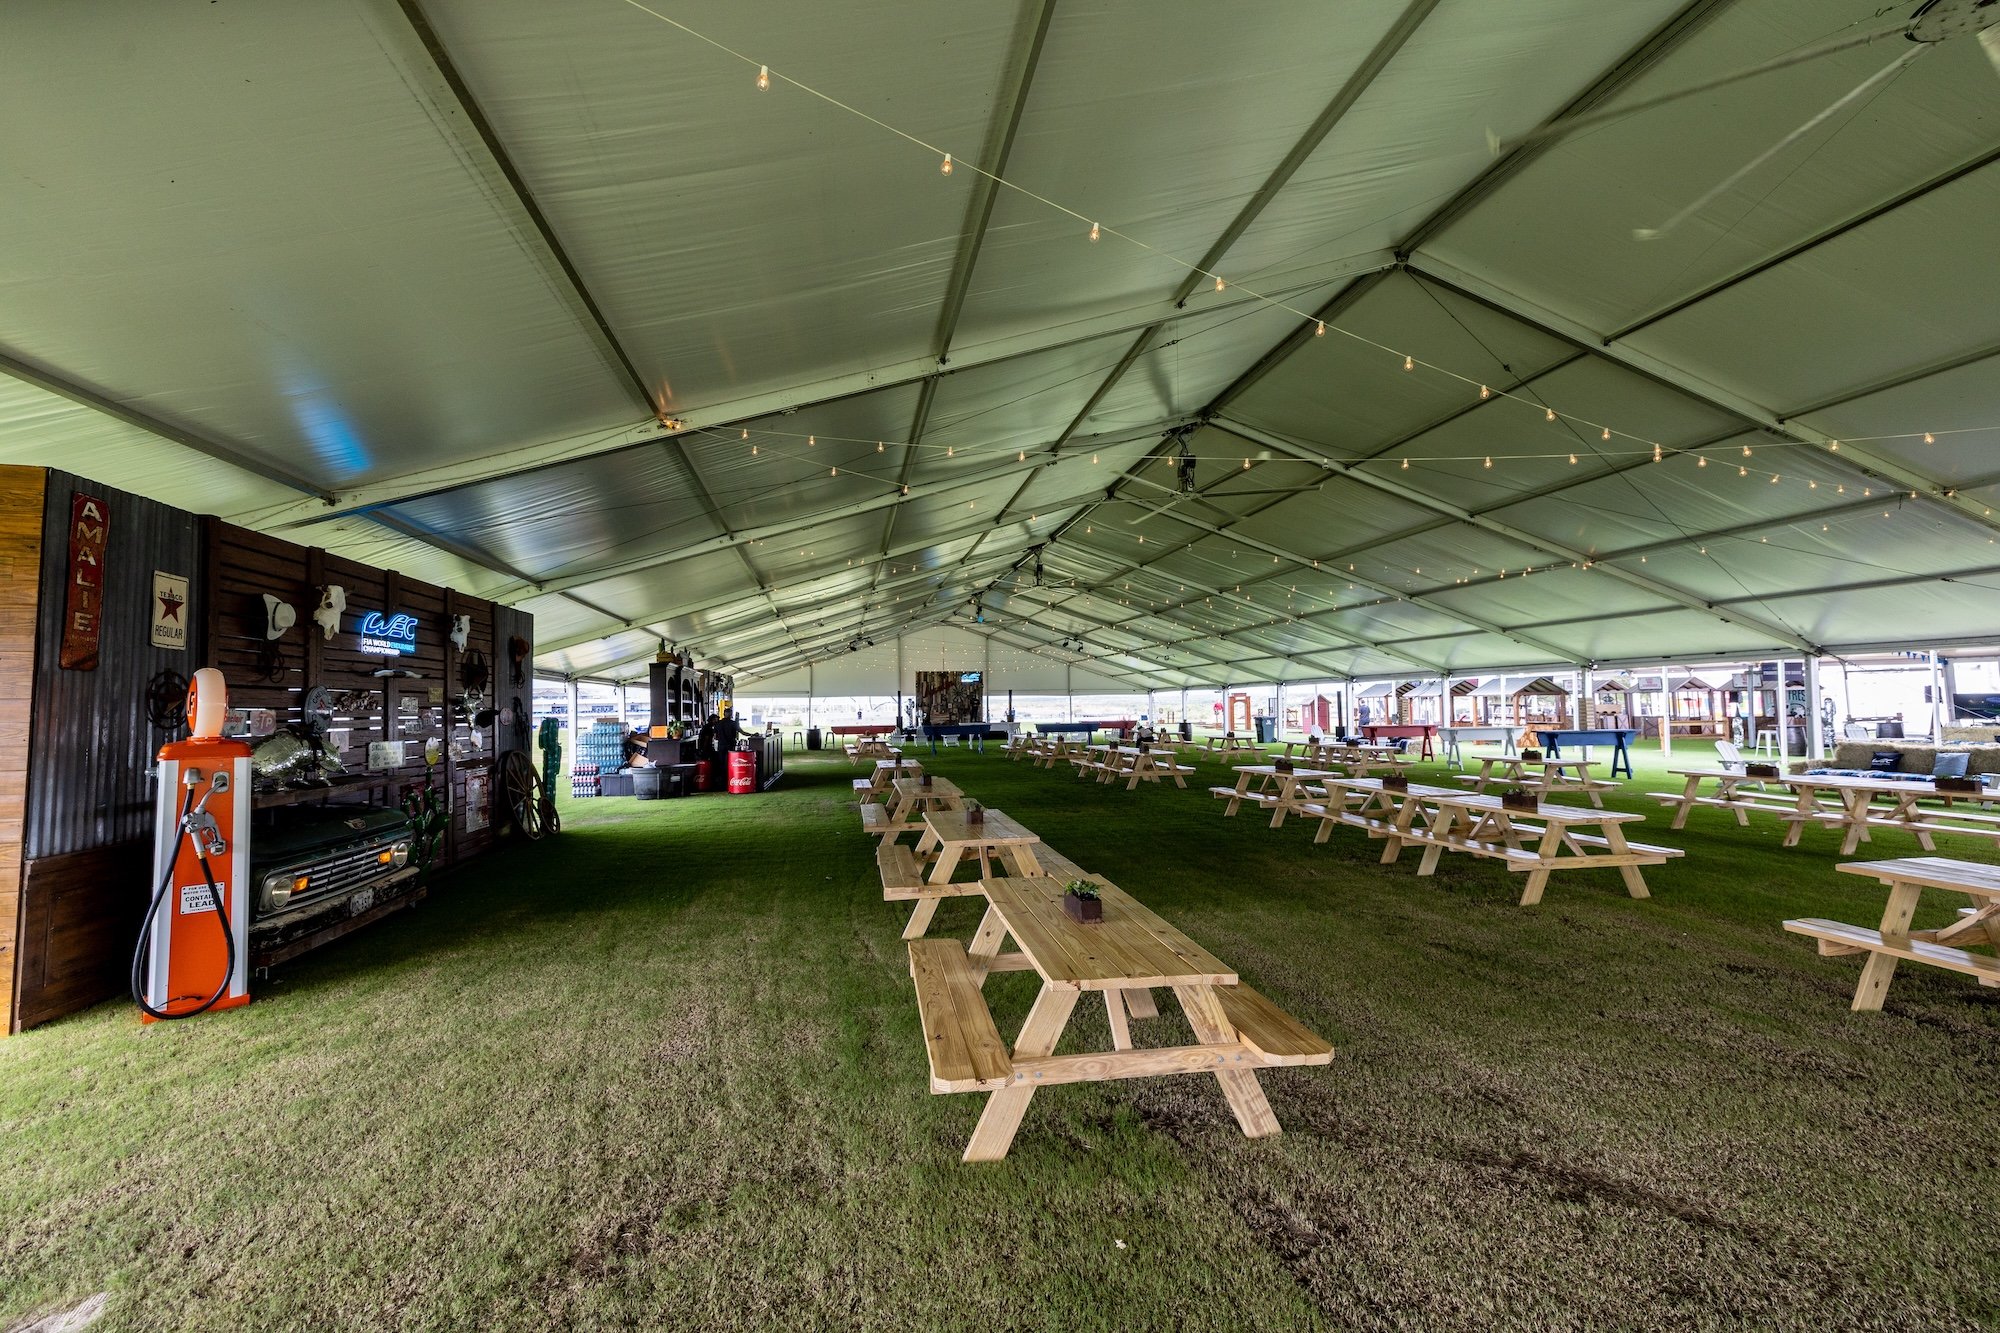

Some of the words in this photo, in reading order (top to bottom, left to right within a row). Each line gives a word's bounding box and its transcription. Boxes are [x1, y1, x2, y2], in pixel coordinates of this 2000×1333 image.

[73, 501, 103, 632] AMALIE
[154, 624, 183, 640] REGULAR
[363, 611, 418, 640] WEC
[363, 637, 373, 646] FIA
[373, 639, 391, 648] WORLD
[363, 645, 400, 656] CHAMPIONSHIP
[253, 713, 273, 730] STP
[189, 899, 215, 909] LEAD
